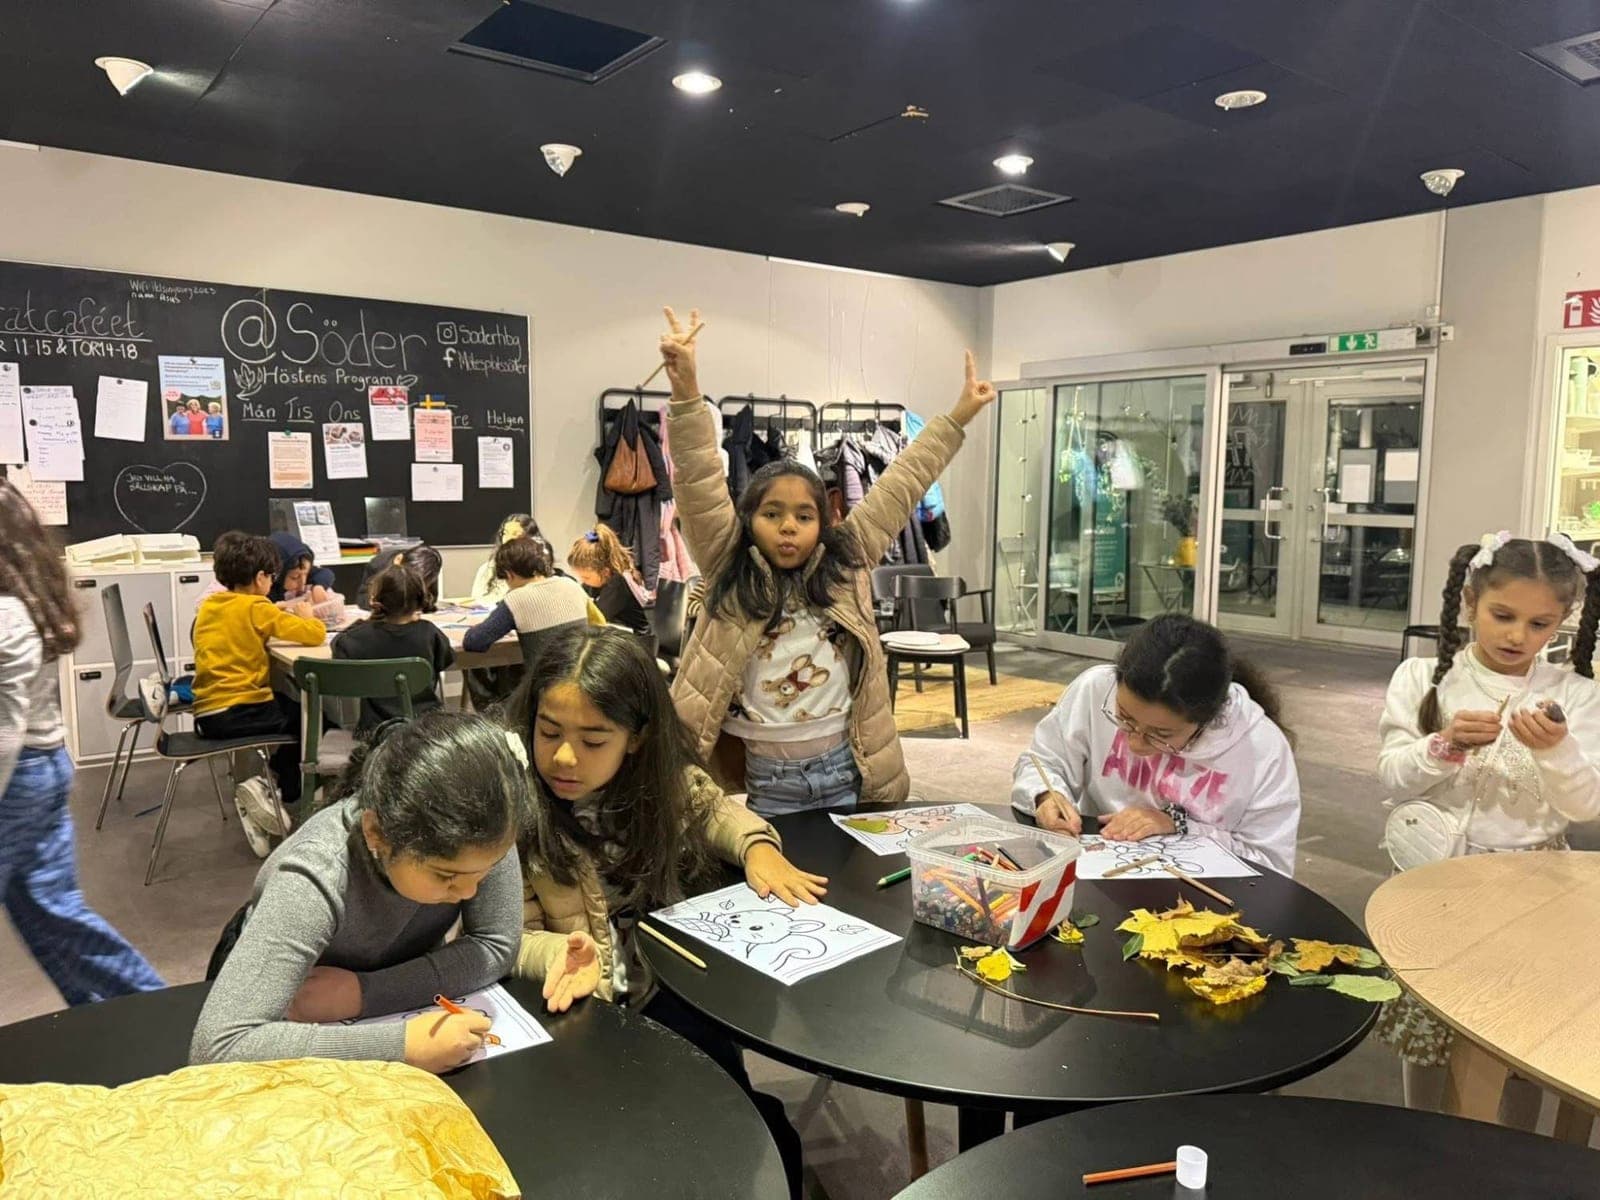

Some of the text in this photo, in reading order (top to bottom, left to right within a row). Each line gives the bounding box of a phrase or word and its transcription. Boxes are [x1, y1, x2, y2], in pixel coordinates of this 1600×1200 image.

[0, 288, 144, 339] atcaféet
[263, 366, 394, 392] Höstens Program
[242, 402, 276, 419] Mån
[285, 396, 314, 420] Tis
[328, 400, 361, 423] Ons
[486, 409, 524, 431] Helgen
